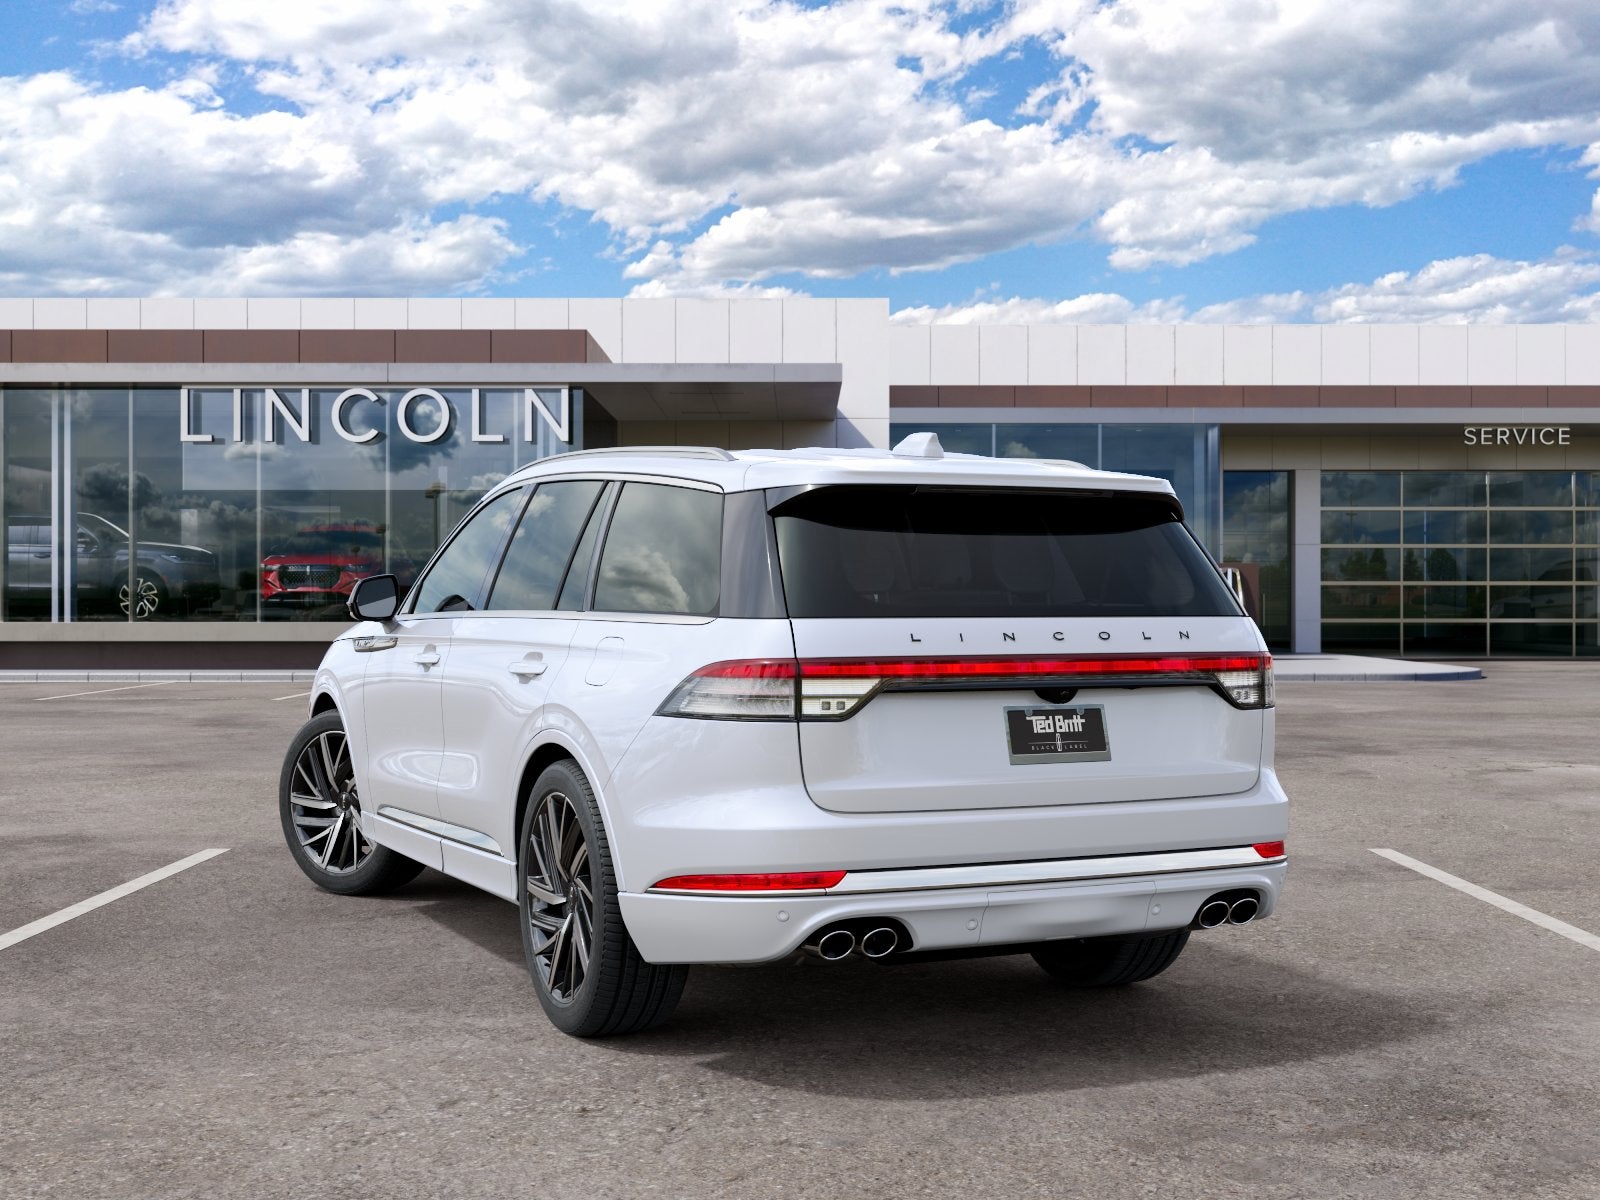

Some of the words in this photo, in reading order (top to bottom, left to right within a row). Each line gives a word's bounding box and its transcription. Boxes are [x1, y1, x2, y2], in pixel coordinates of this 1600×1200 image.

[180, 387, 569, 443] LINCOLN
[1464, 427, 1571, 445] SERVICE
[910, 630, 1191, 643] LINCOLN
[1026, 715, 1054, 733] Ted
